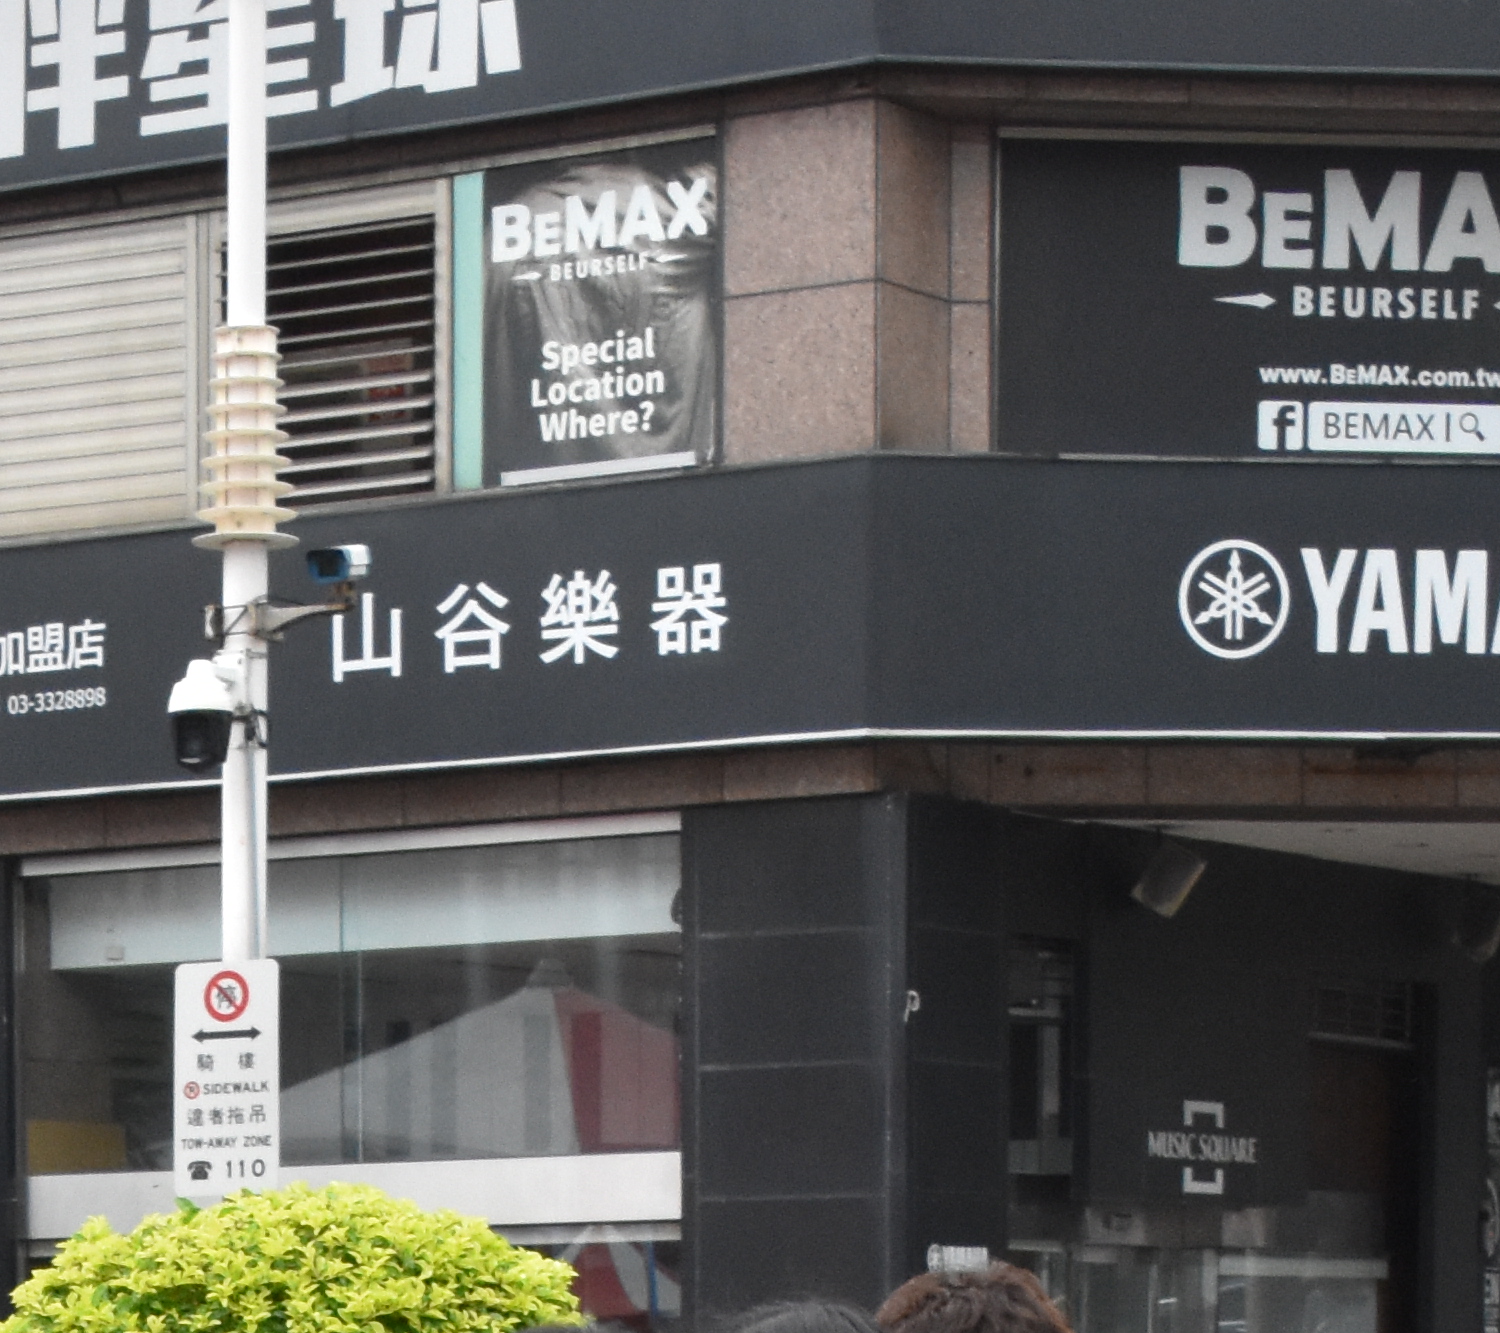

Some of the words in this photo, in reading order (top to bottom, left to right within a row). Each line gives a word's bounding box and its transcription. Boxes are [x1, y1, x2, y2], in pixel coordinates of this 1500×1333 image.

[550, 253, 650, 281] BEURSELF
[1292, 285, 1480, 321] BEURSELF
[541, 327, 656, 375] Special
[531, 366, 665, 408] Location
[538, 401, 655, 442] Where?
[1323, 412, 1436, 442] BEMAX
[330, 561, 730, 684] 山谷樂器
[6, 687, 107, 716] 03-3328898
[202, 1081, 270, 1096] SIDEWALK
[186, 1103, 267, 1127] 違者拖吊
[180, 1136, 238, 1151] TOW-AWAY
[242, 1134, 273, 1148] ZONE
[225, 1158, 267, 1180] 110
